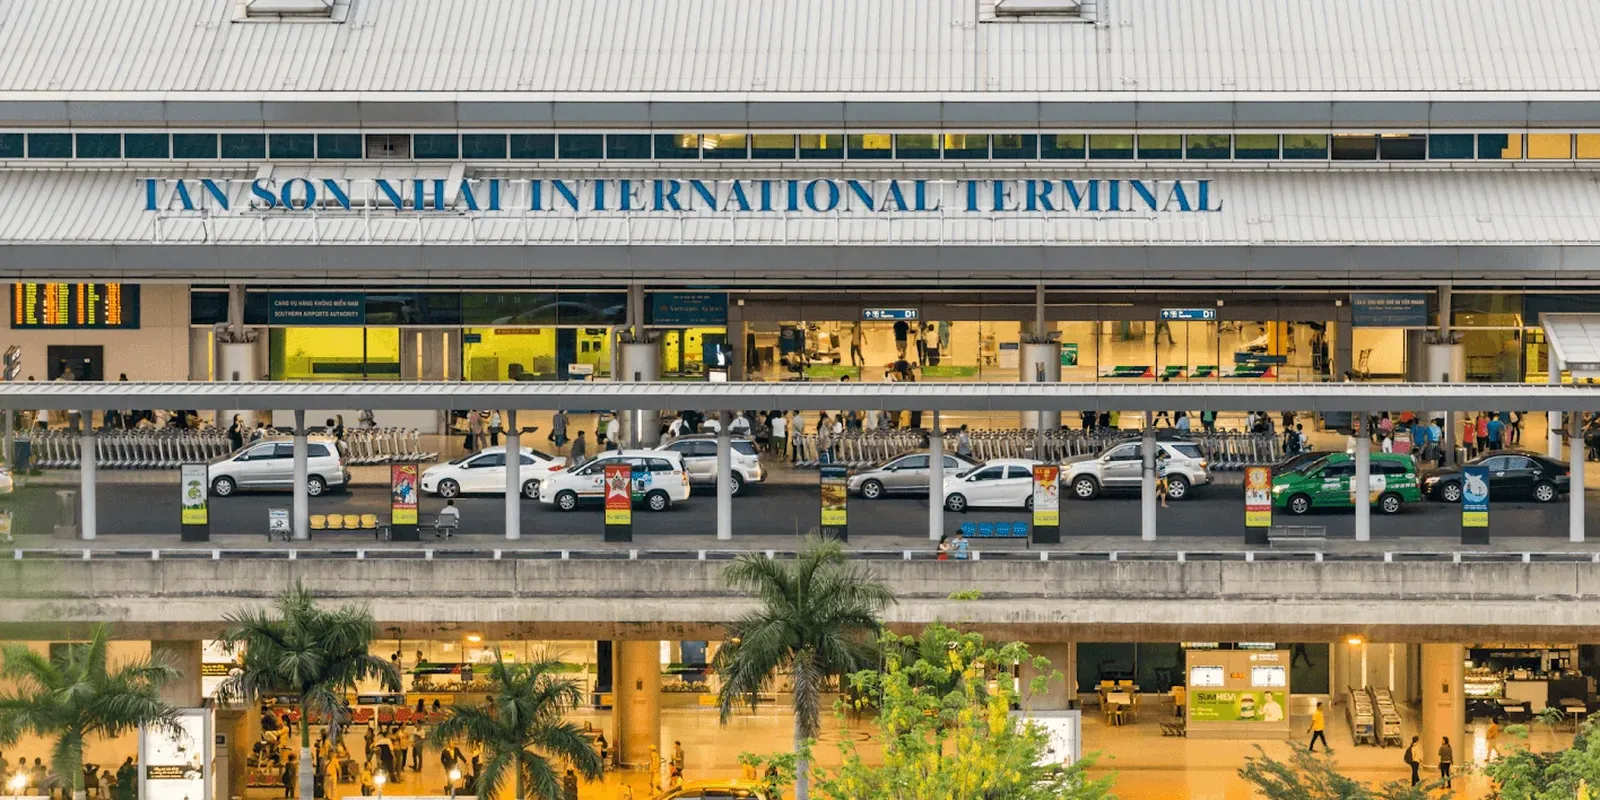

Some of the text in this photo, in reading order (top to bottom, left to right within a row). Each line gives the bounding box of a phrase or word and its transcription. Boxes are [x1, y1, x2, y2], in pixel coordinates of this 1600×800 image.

[136, 177, 1224, 212] TAN SON NHAT INTERNATIONAL TERMINAL
[904, 310, 916, 318] D1
[1202, 310, 1214, 318] D1
